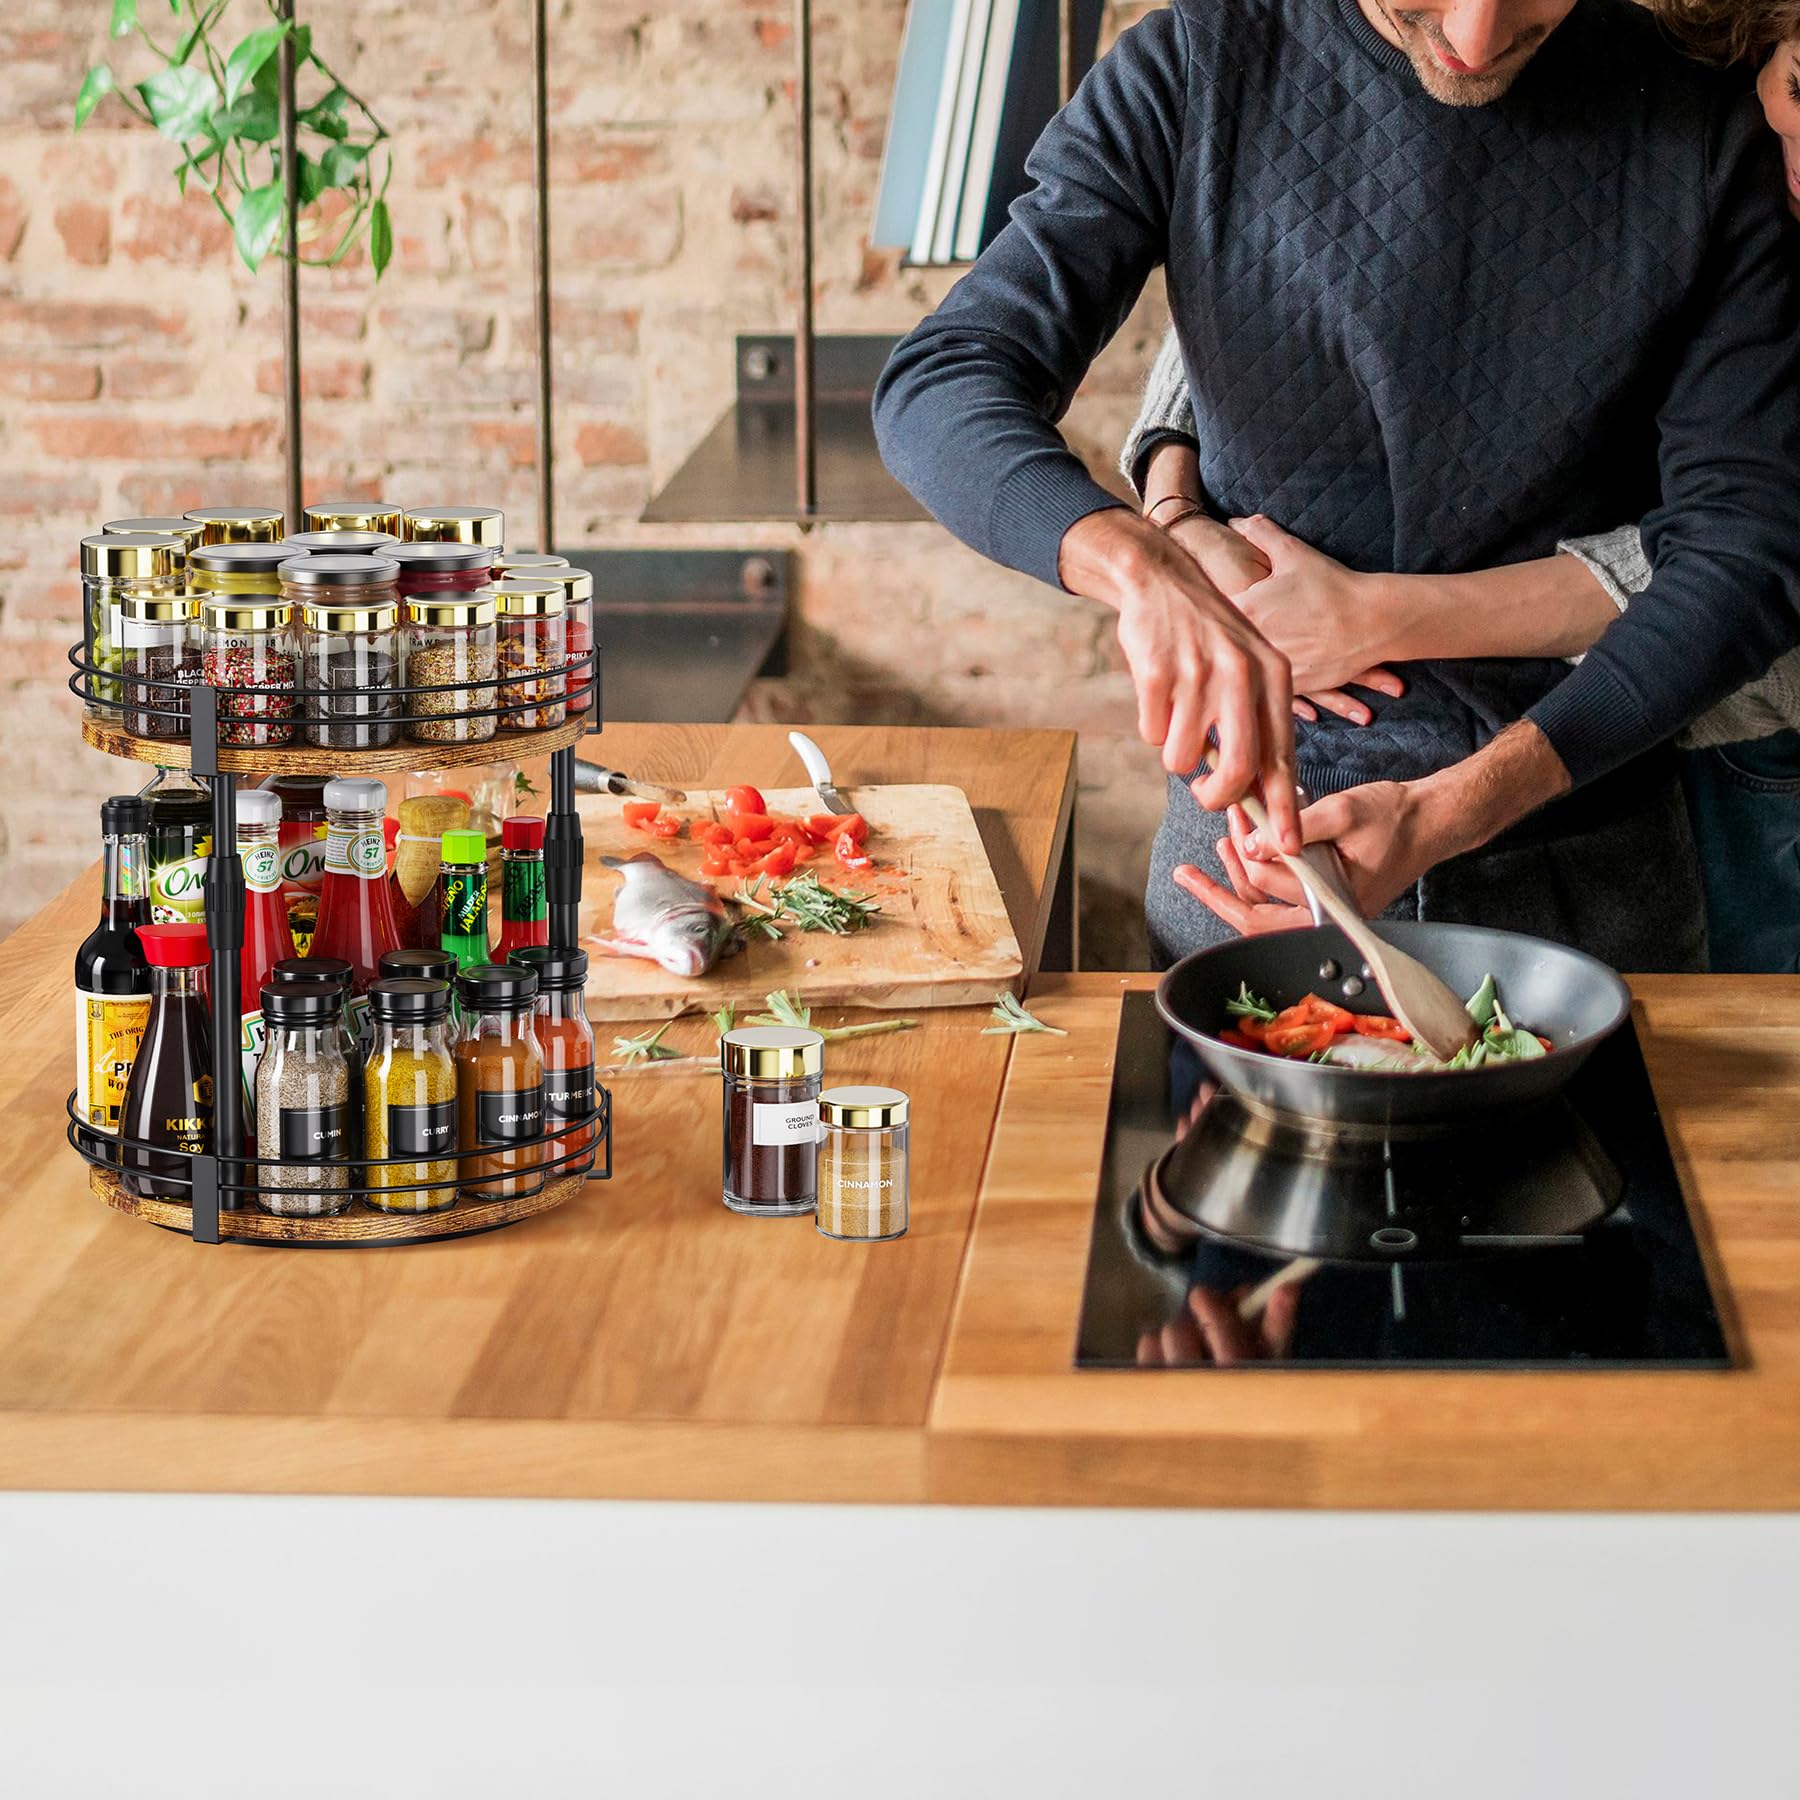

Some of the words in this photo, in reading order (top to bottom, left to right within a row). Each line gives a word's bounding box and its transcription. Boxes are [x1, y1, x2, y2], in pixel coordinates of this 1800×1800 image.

[177, 668, 205, 678] BLAC
[361, 837, 381, 848] HEINZ
[254, 850, 275, 861] HEINZ
[362, 847, 380, 860] 57
[256, 860, 274, 873] 57
[457, 890, 480, 920] MILDER
[109, 1029, 125, 1040] THE
[125, 1025, 146, 1036] ORIG
[548, 1087, 593, 1102] TURMERIC
[785, 1113, 815, 1124] GROUND
[422, 1125, 450, 1137] CURRY
[787, 1120, 813, 1130] CLOVES
[313, 1128, 342, 1140] CUMIN
[179, 1142, 204, 1154] Soy
[837, 1179, 893, 1189] CINNAMON
